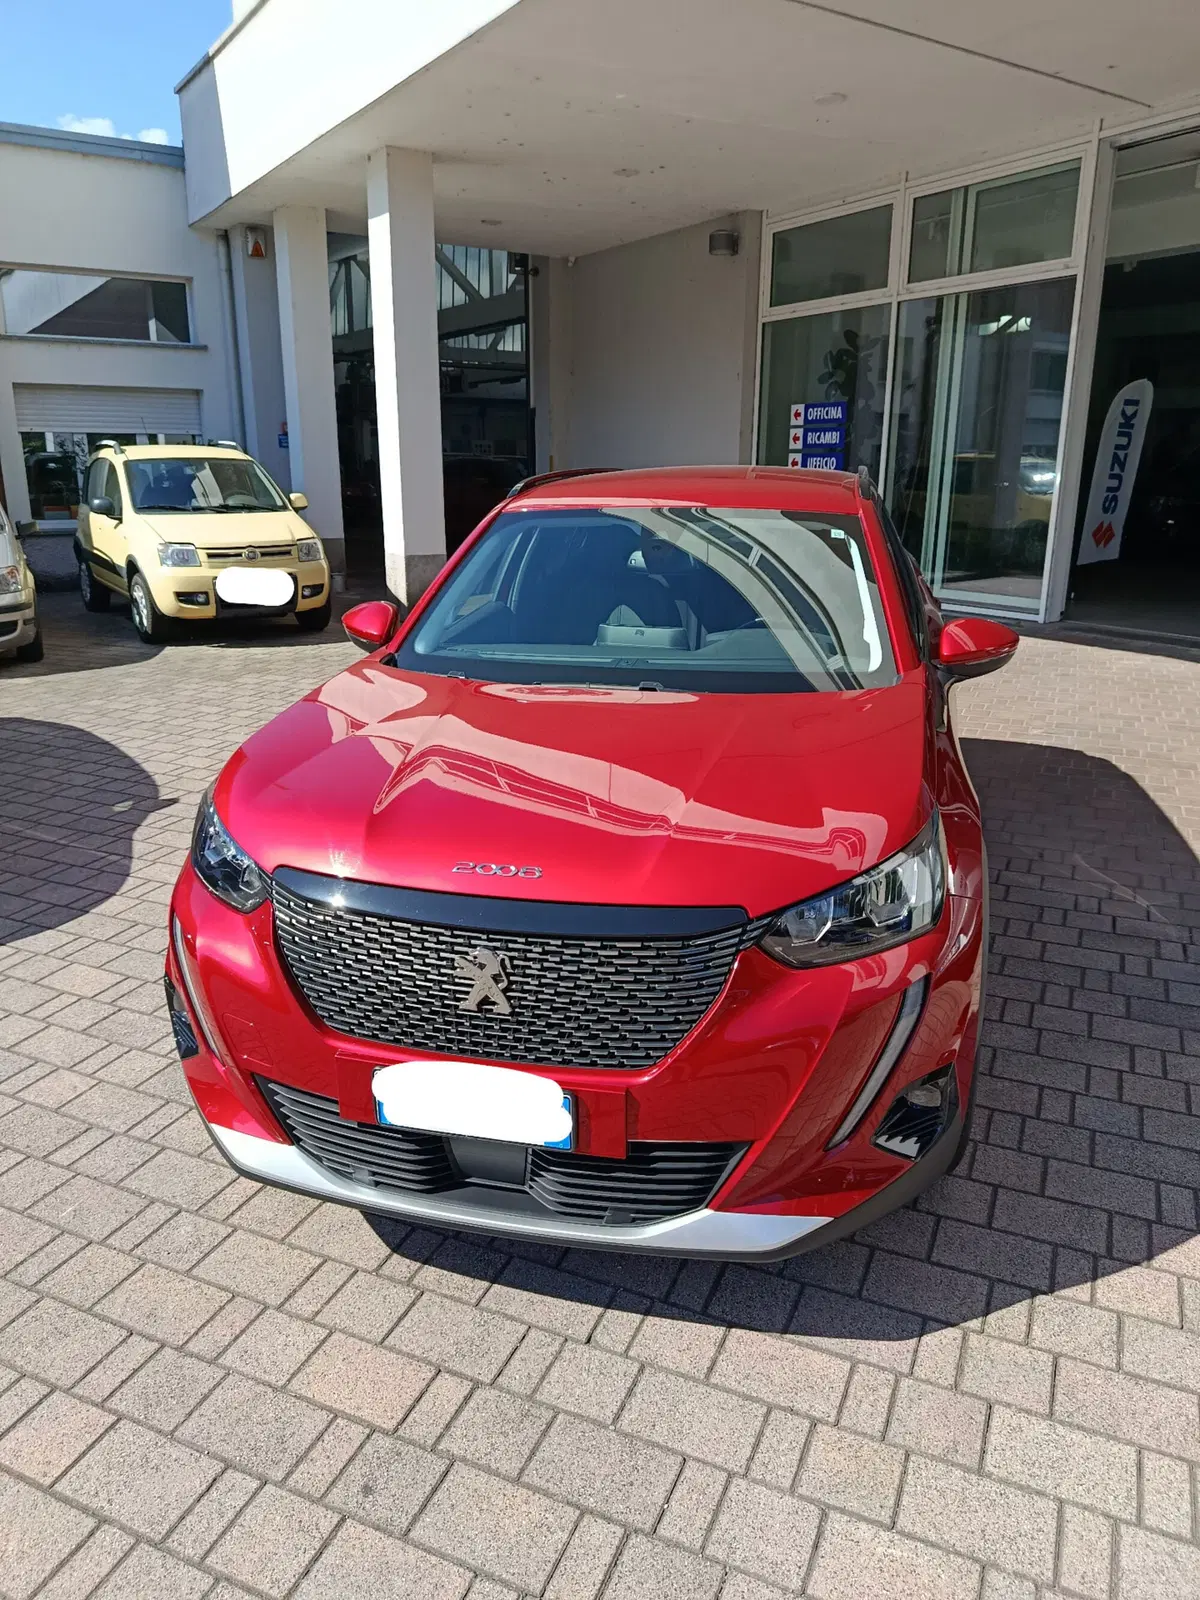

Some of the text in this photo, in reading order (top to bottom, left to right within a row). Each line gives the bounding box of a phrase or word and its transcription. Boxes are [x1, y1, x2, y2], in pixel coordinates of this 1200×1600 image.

[807, 406, 842, 420] OFFICINA
[806, 431, 840, 445] RICAMBI
[806, 457, 837, 470] UFFICIO
[1102, 398, 1141, 515] SUZUKI
[452, 861, 543, 879] 2008
